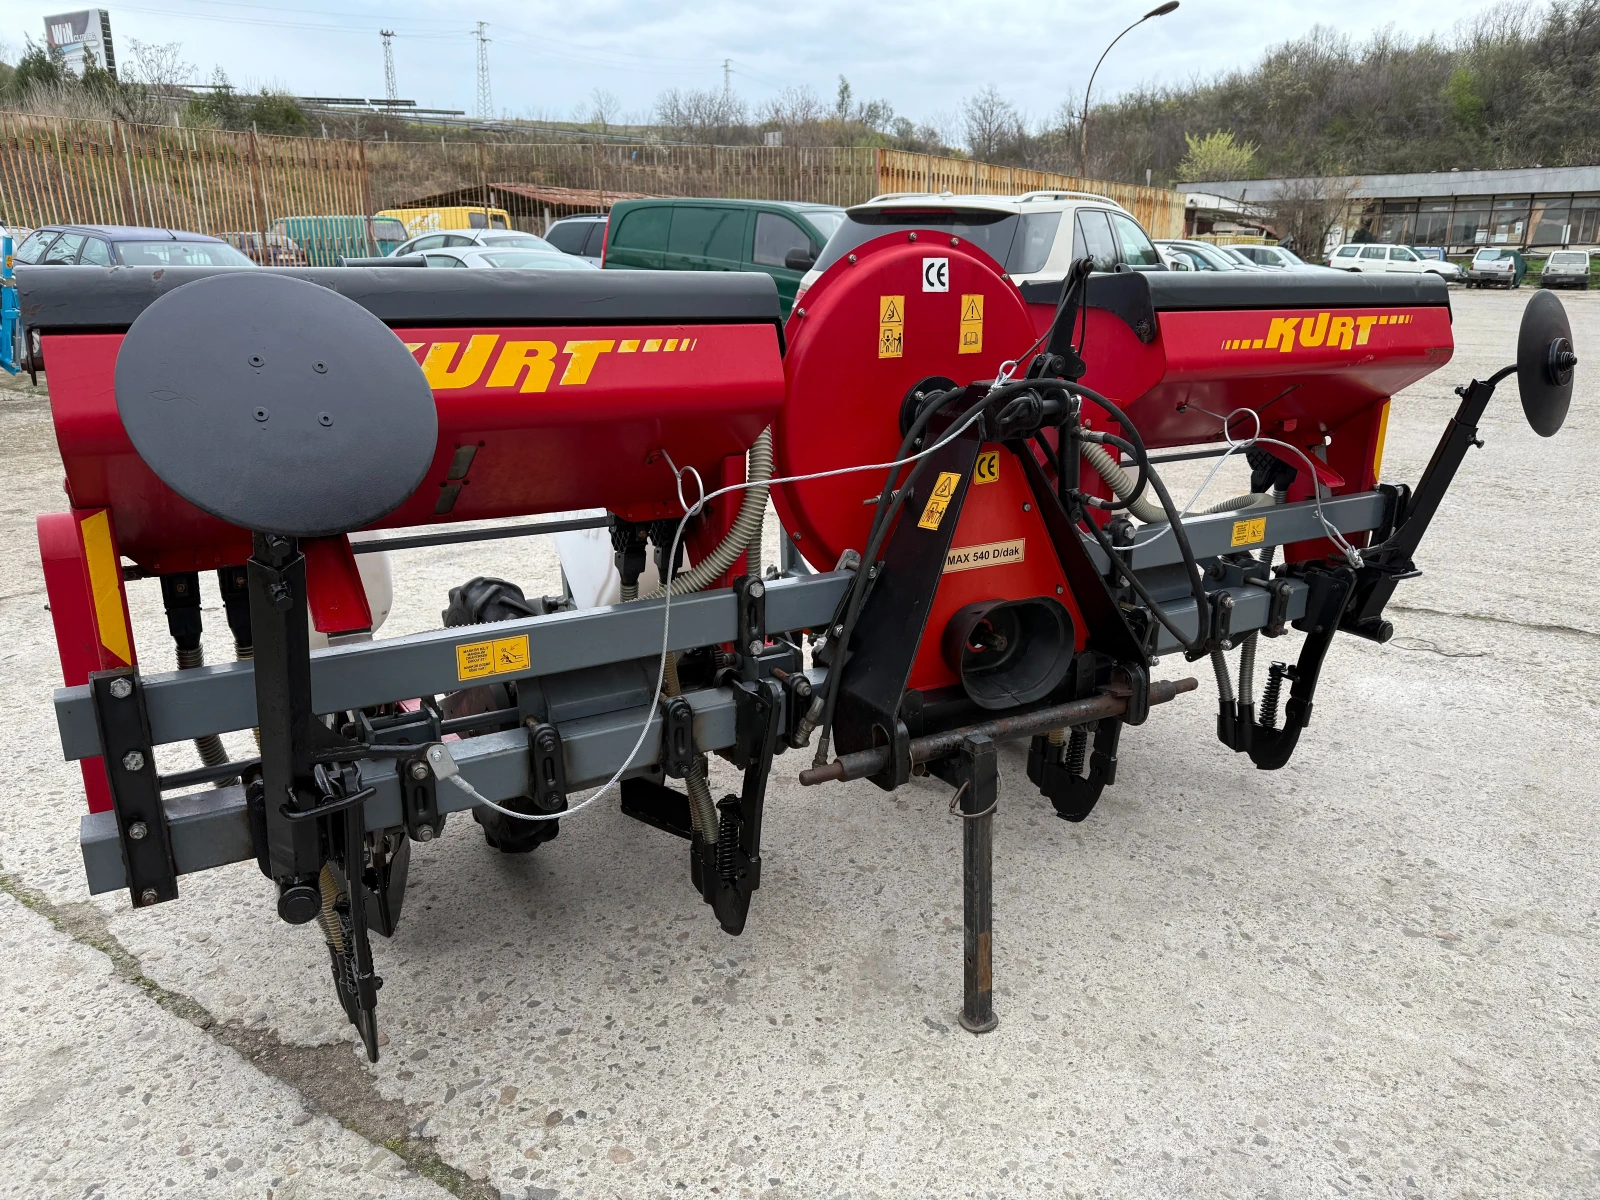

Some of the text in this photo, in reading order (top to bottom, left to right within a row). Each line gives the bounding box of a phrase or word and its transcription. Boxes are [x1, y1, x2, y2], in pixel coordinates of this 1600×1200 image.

[925, 262, 946, 287] CE
[1264, 312, 1378, 353] KURT
[404, 334, 616, 394] URT
[977, 454, 996, 479] CE
[947, 546, 1020, 565] MAX 540 D/dak
